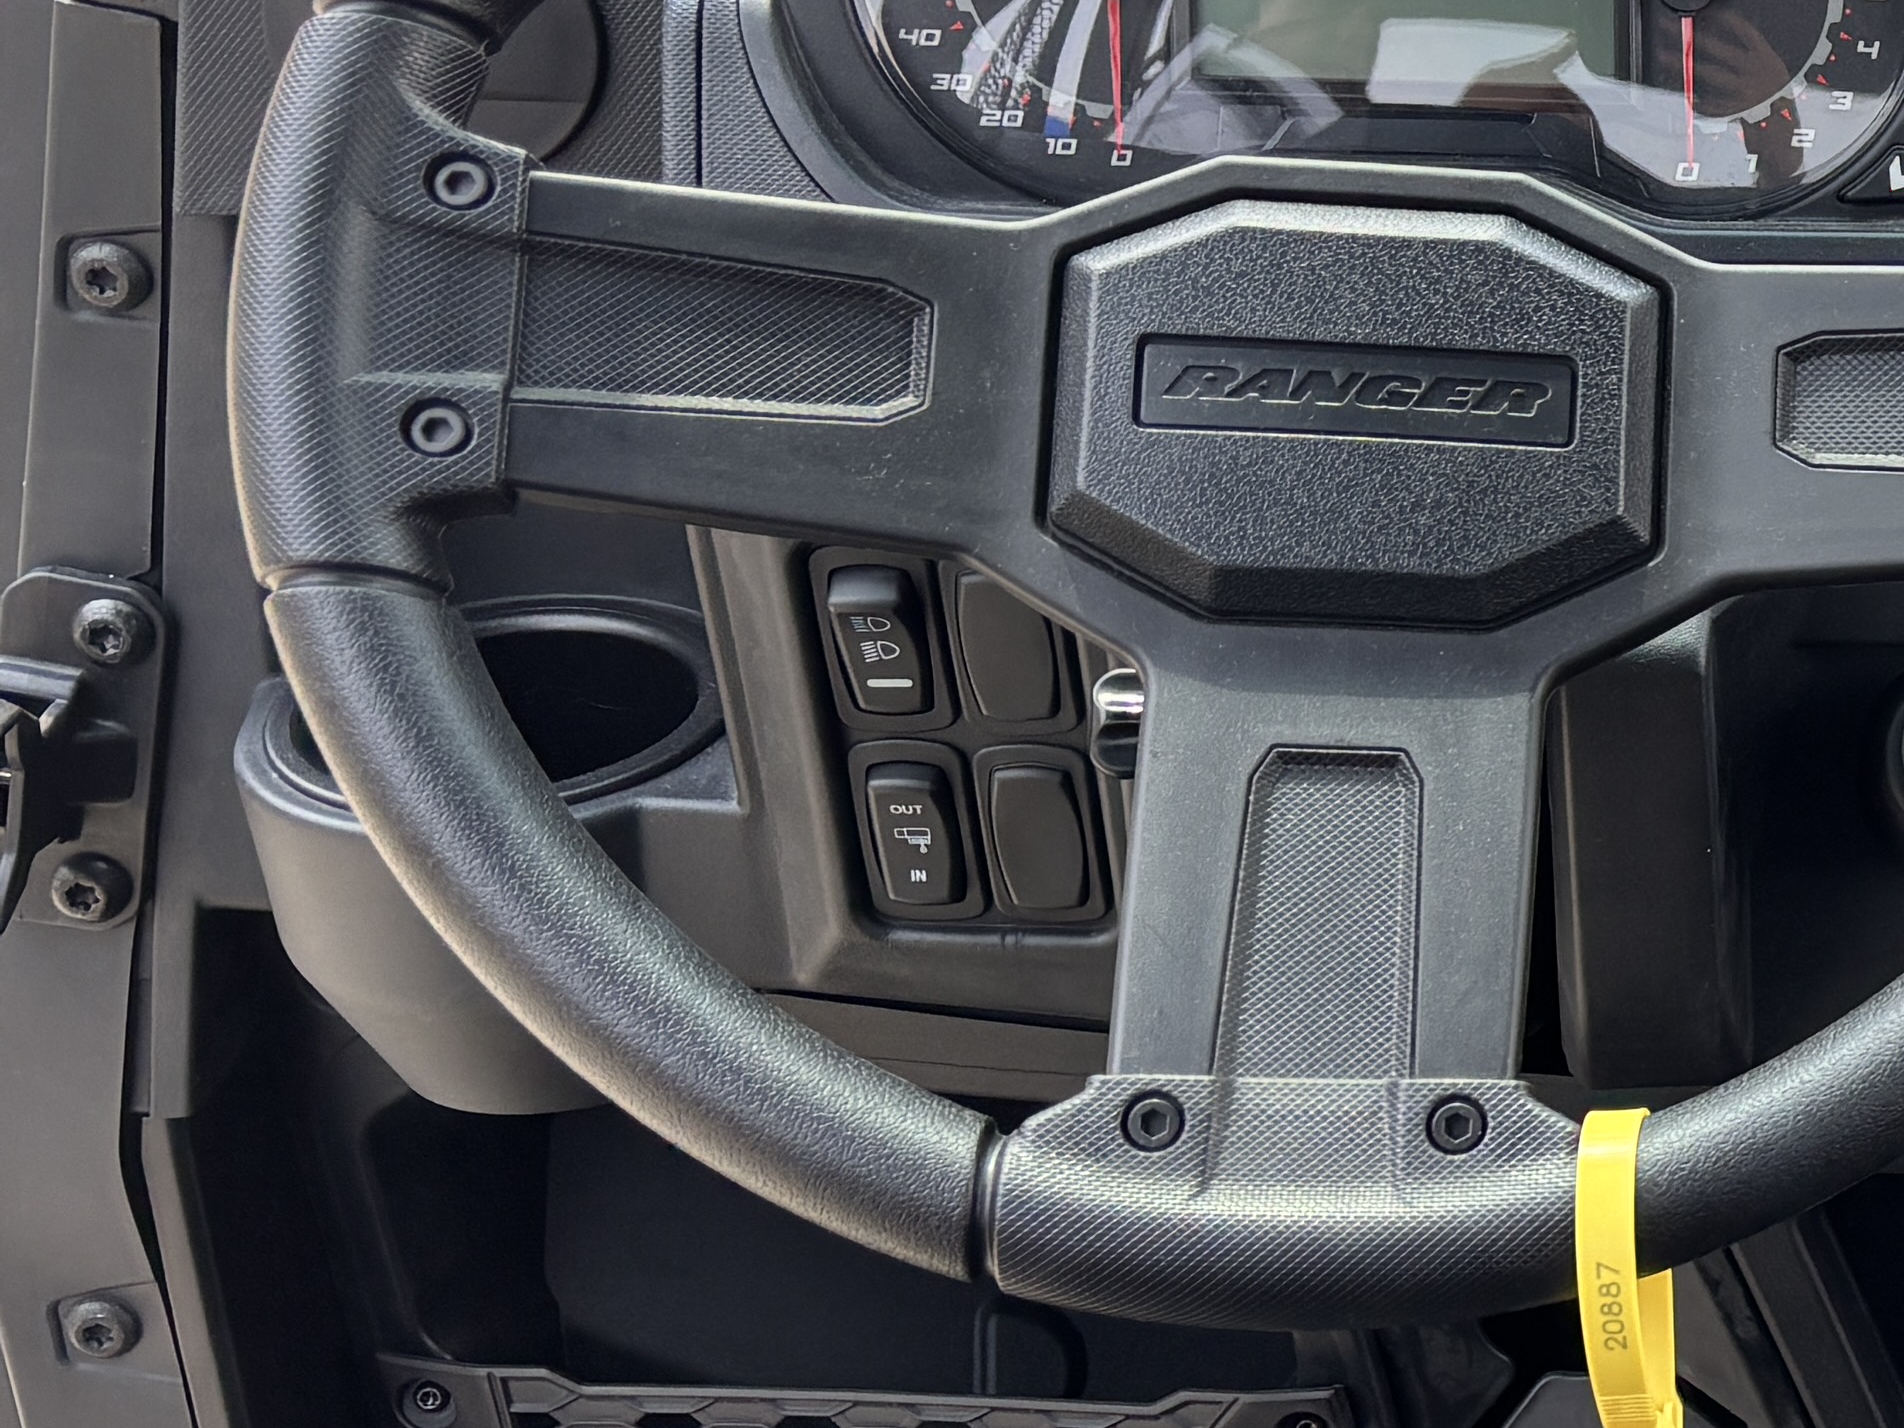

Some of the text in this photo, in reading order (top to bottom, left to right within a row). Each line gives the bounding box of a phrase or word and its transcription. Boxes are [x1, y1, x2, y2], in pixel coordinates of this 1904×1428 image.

[899, 28, 942, 47] 40
[1857, 40, 1880, 60] 4
[930, 74, 972, 91] 30
[1829, 90, 1854, 110] 3
[979, 110, 1025, 128] 20
[1045, 138, 1078, 155] 10
[1790, 129, 1816, 147] 2
[1110, 149, 1133, 167] 0
[1746, 154, 1759, 173] 1
[1675, 162, 1700, 181] 0
[1162, 364, 1552, 417] RANGER
[889, 805, 922, 814] OUT
[910, 869, 927, 882] IN
[1596, 1261, 1628, 1352] 20887
